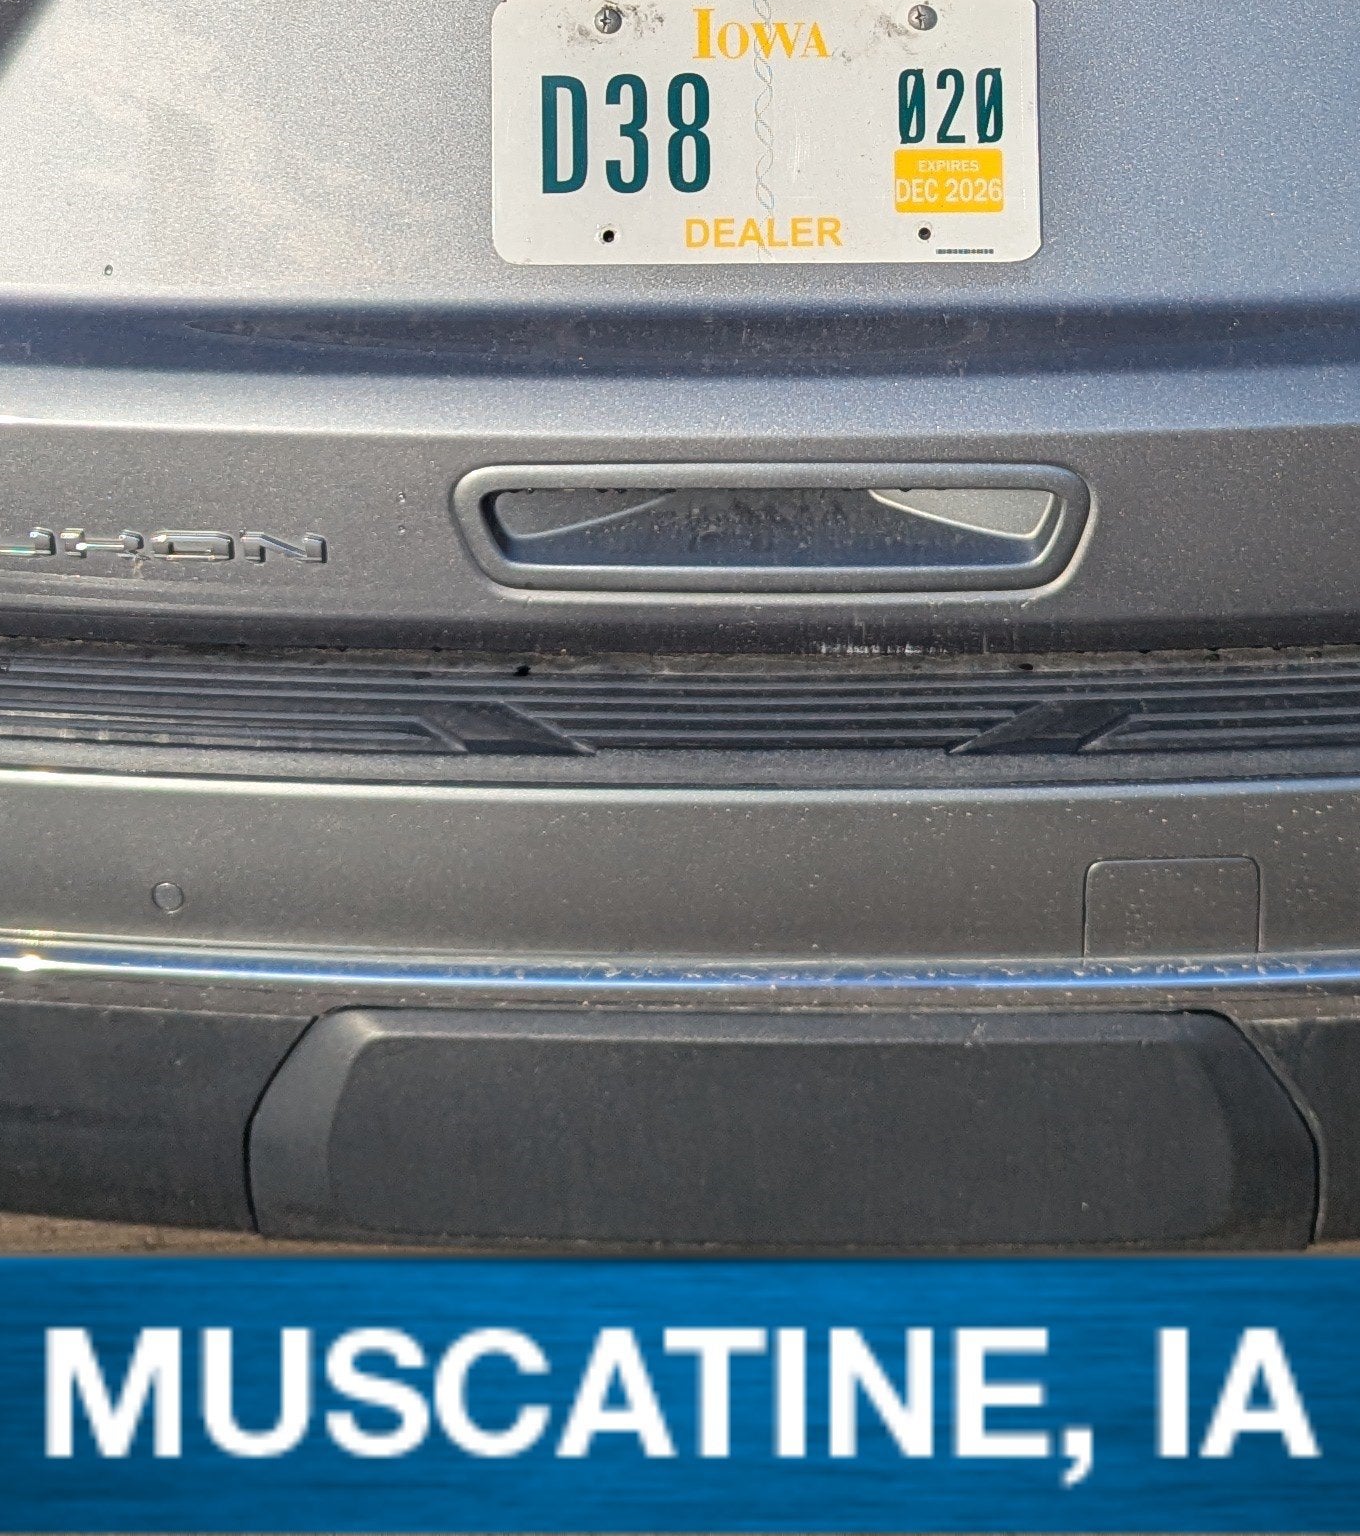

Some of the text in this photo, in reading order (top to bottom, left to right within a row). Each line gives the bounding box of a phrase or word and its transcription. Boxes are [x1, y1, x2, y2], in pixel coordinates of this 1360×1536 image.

[541, 67, 1004, 194] D38 020
[918, 159, 981, 173] EXPIRES
[895, 178, 1004, 203] DEC 2026
[684, 216, 844, 249] DEALER
